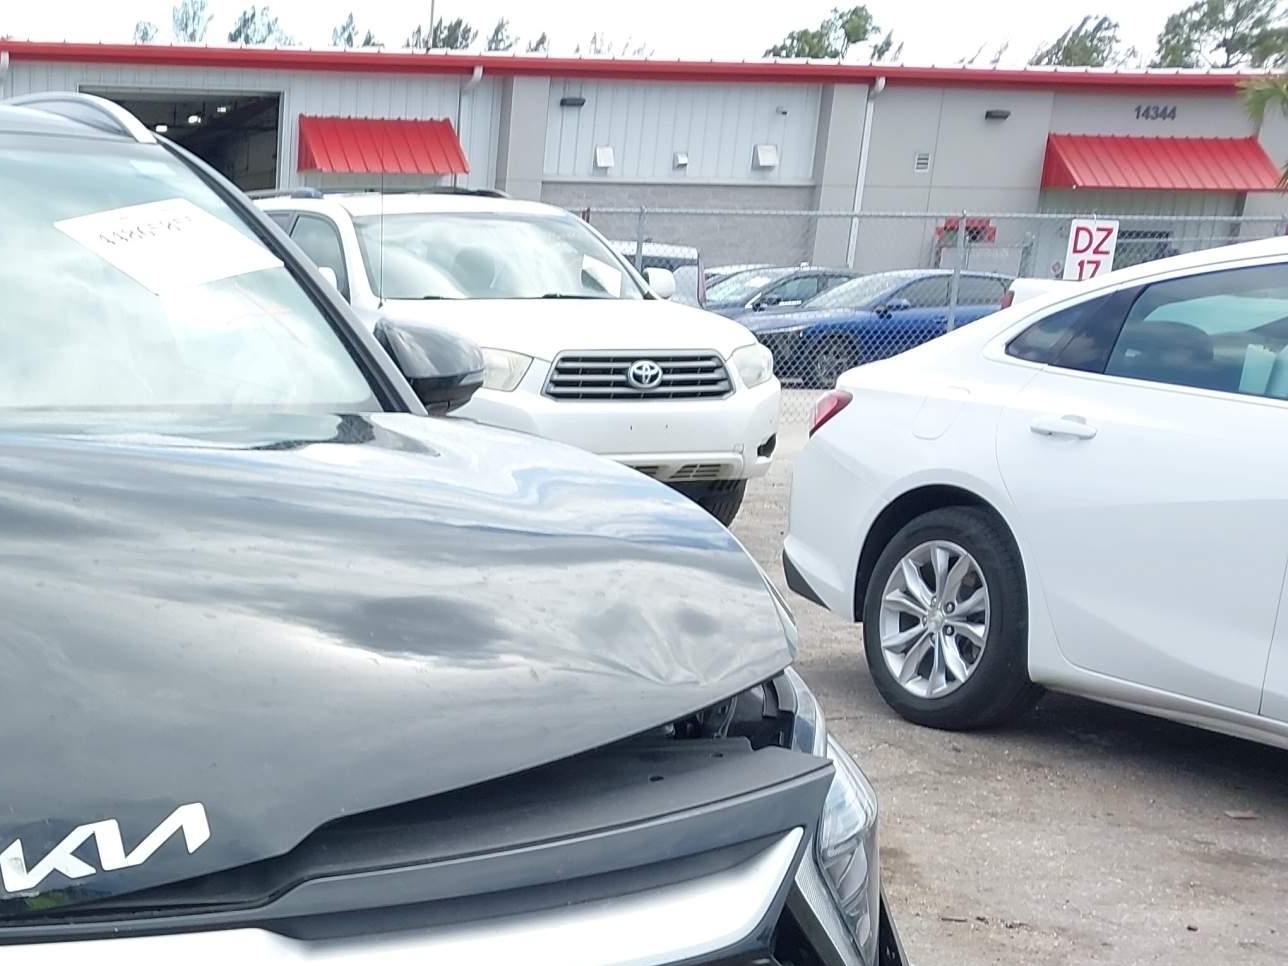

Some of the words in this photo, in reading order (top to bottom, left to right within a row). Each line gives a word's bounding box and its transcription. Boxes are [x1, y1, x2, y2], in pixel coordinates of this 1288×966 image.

[1134, 104, 1177, 121] 14344
[1072, 226, 1114, 255] DZ
[1077, 259, 1101, 282] 17
[0, 802, 211, 893] KIA
